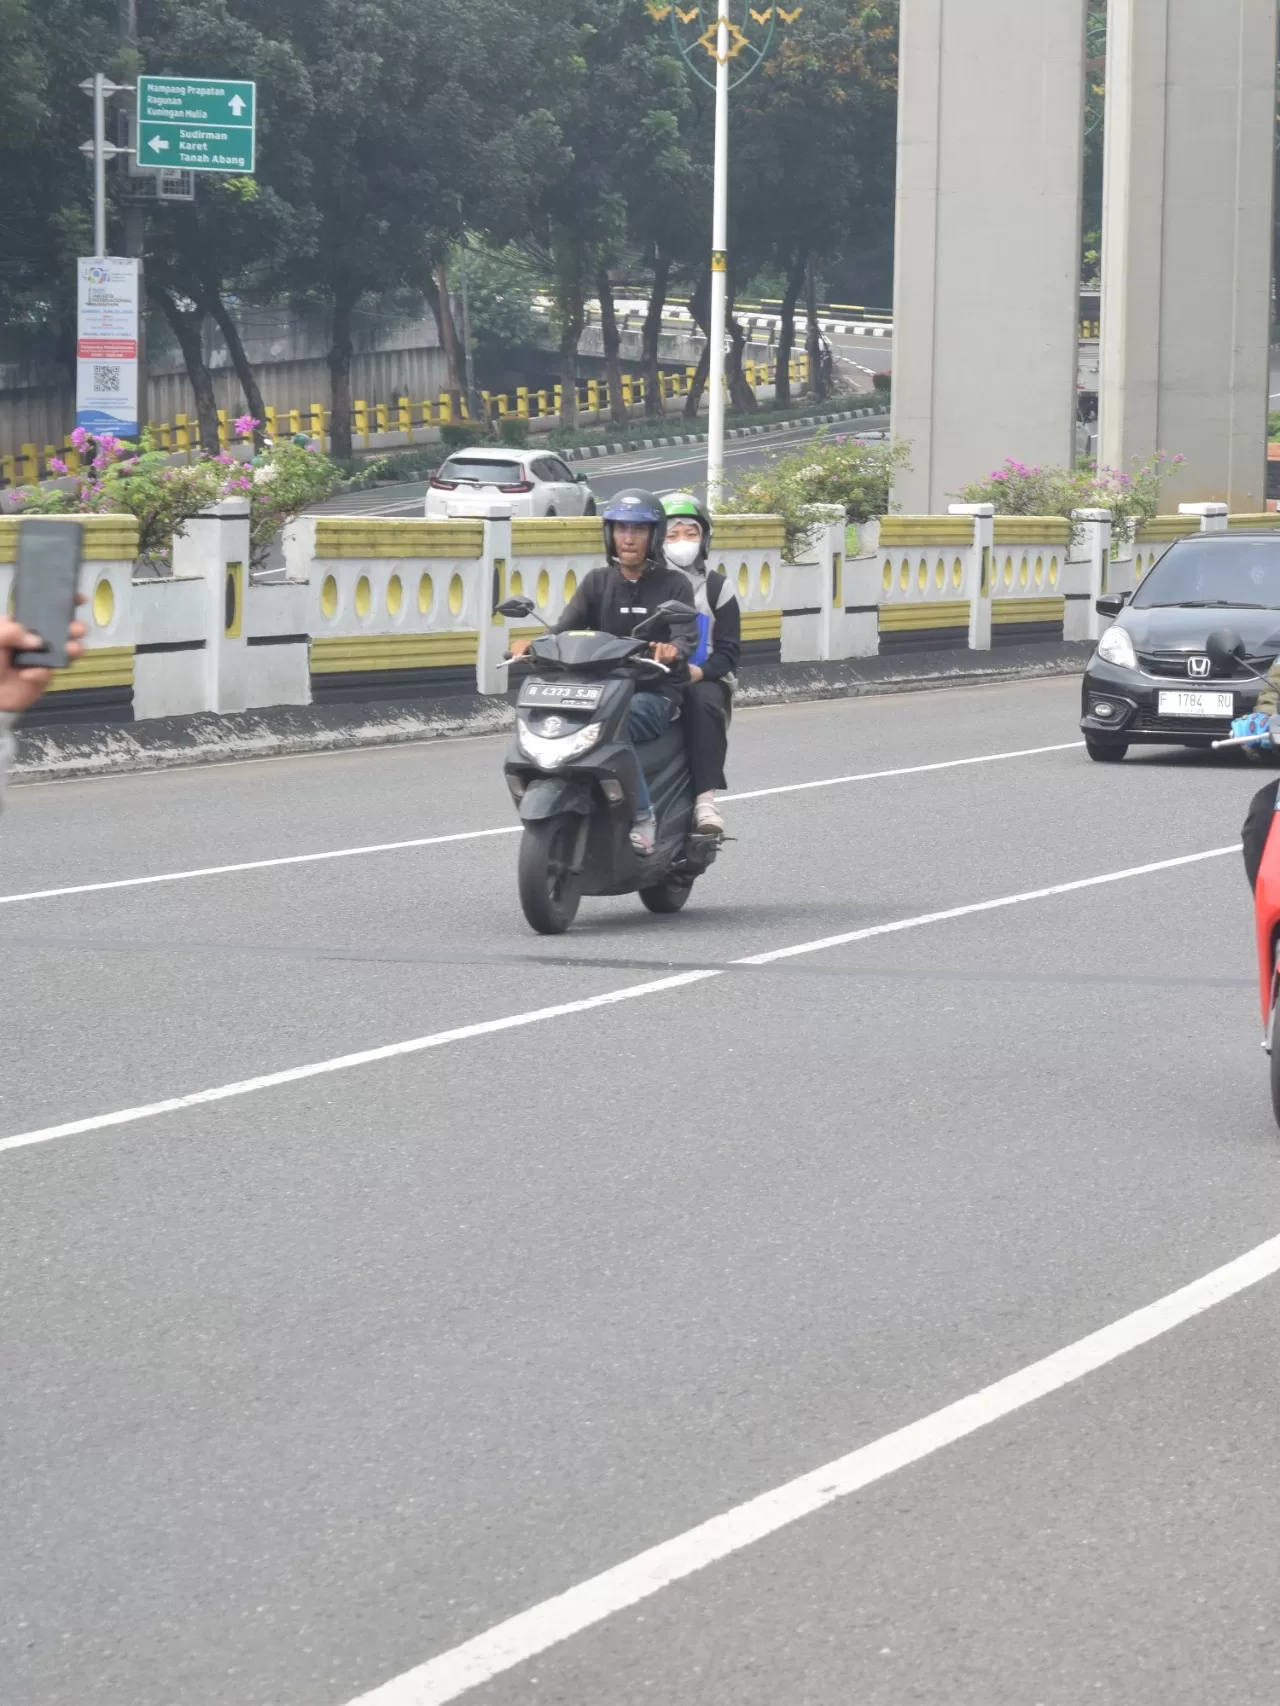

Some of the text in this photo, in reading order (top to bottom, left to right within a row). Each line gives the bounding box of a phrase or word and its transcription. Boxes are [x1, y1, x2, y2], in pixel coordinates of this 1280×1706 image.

[147, 84, 225, 96] Mampang Prapatan
[147, 96, 182, 107] Ragunan
[147, 108, 208, 119] Kuningan Mulia
[180, 130, 228, 140] Sudirman
[179, 142, 208, 151] Karet
[180, 153, 245, 167] Tanah Abang
[528, 687, 598, 698] B 4373 SJB
[1160, 693, 1231, 708] F 1784 RU
